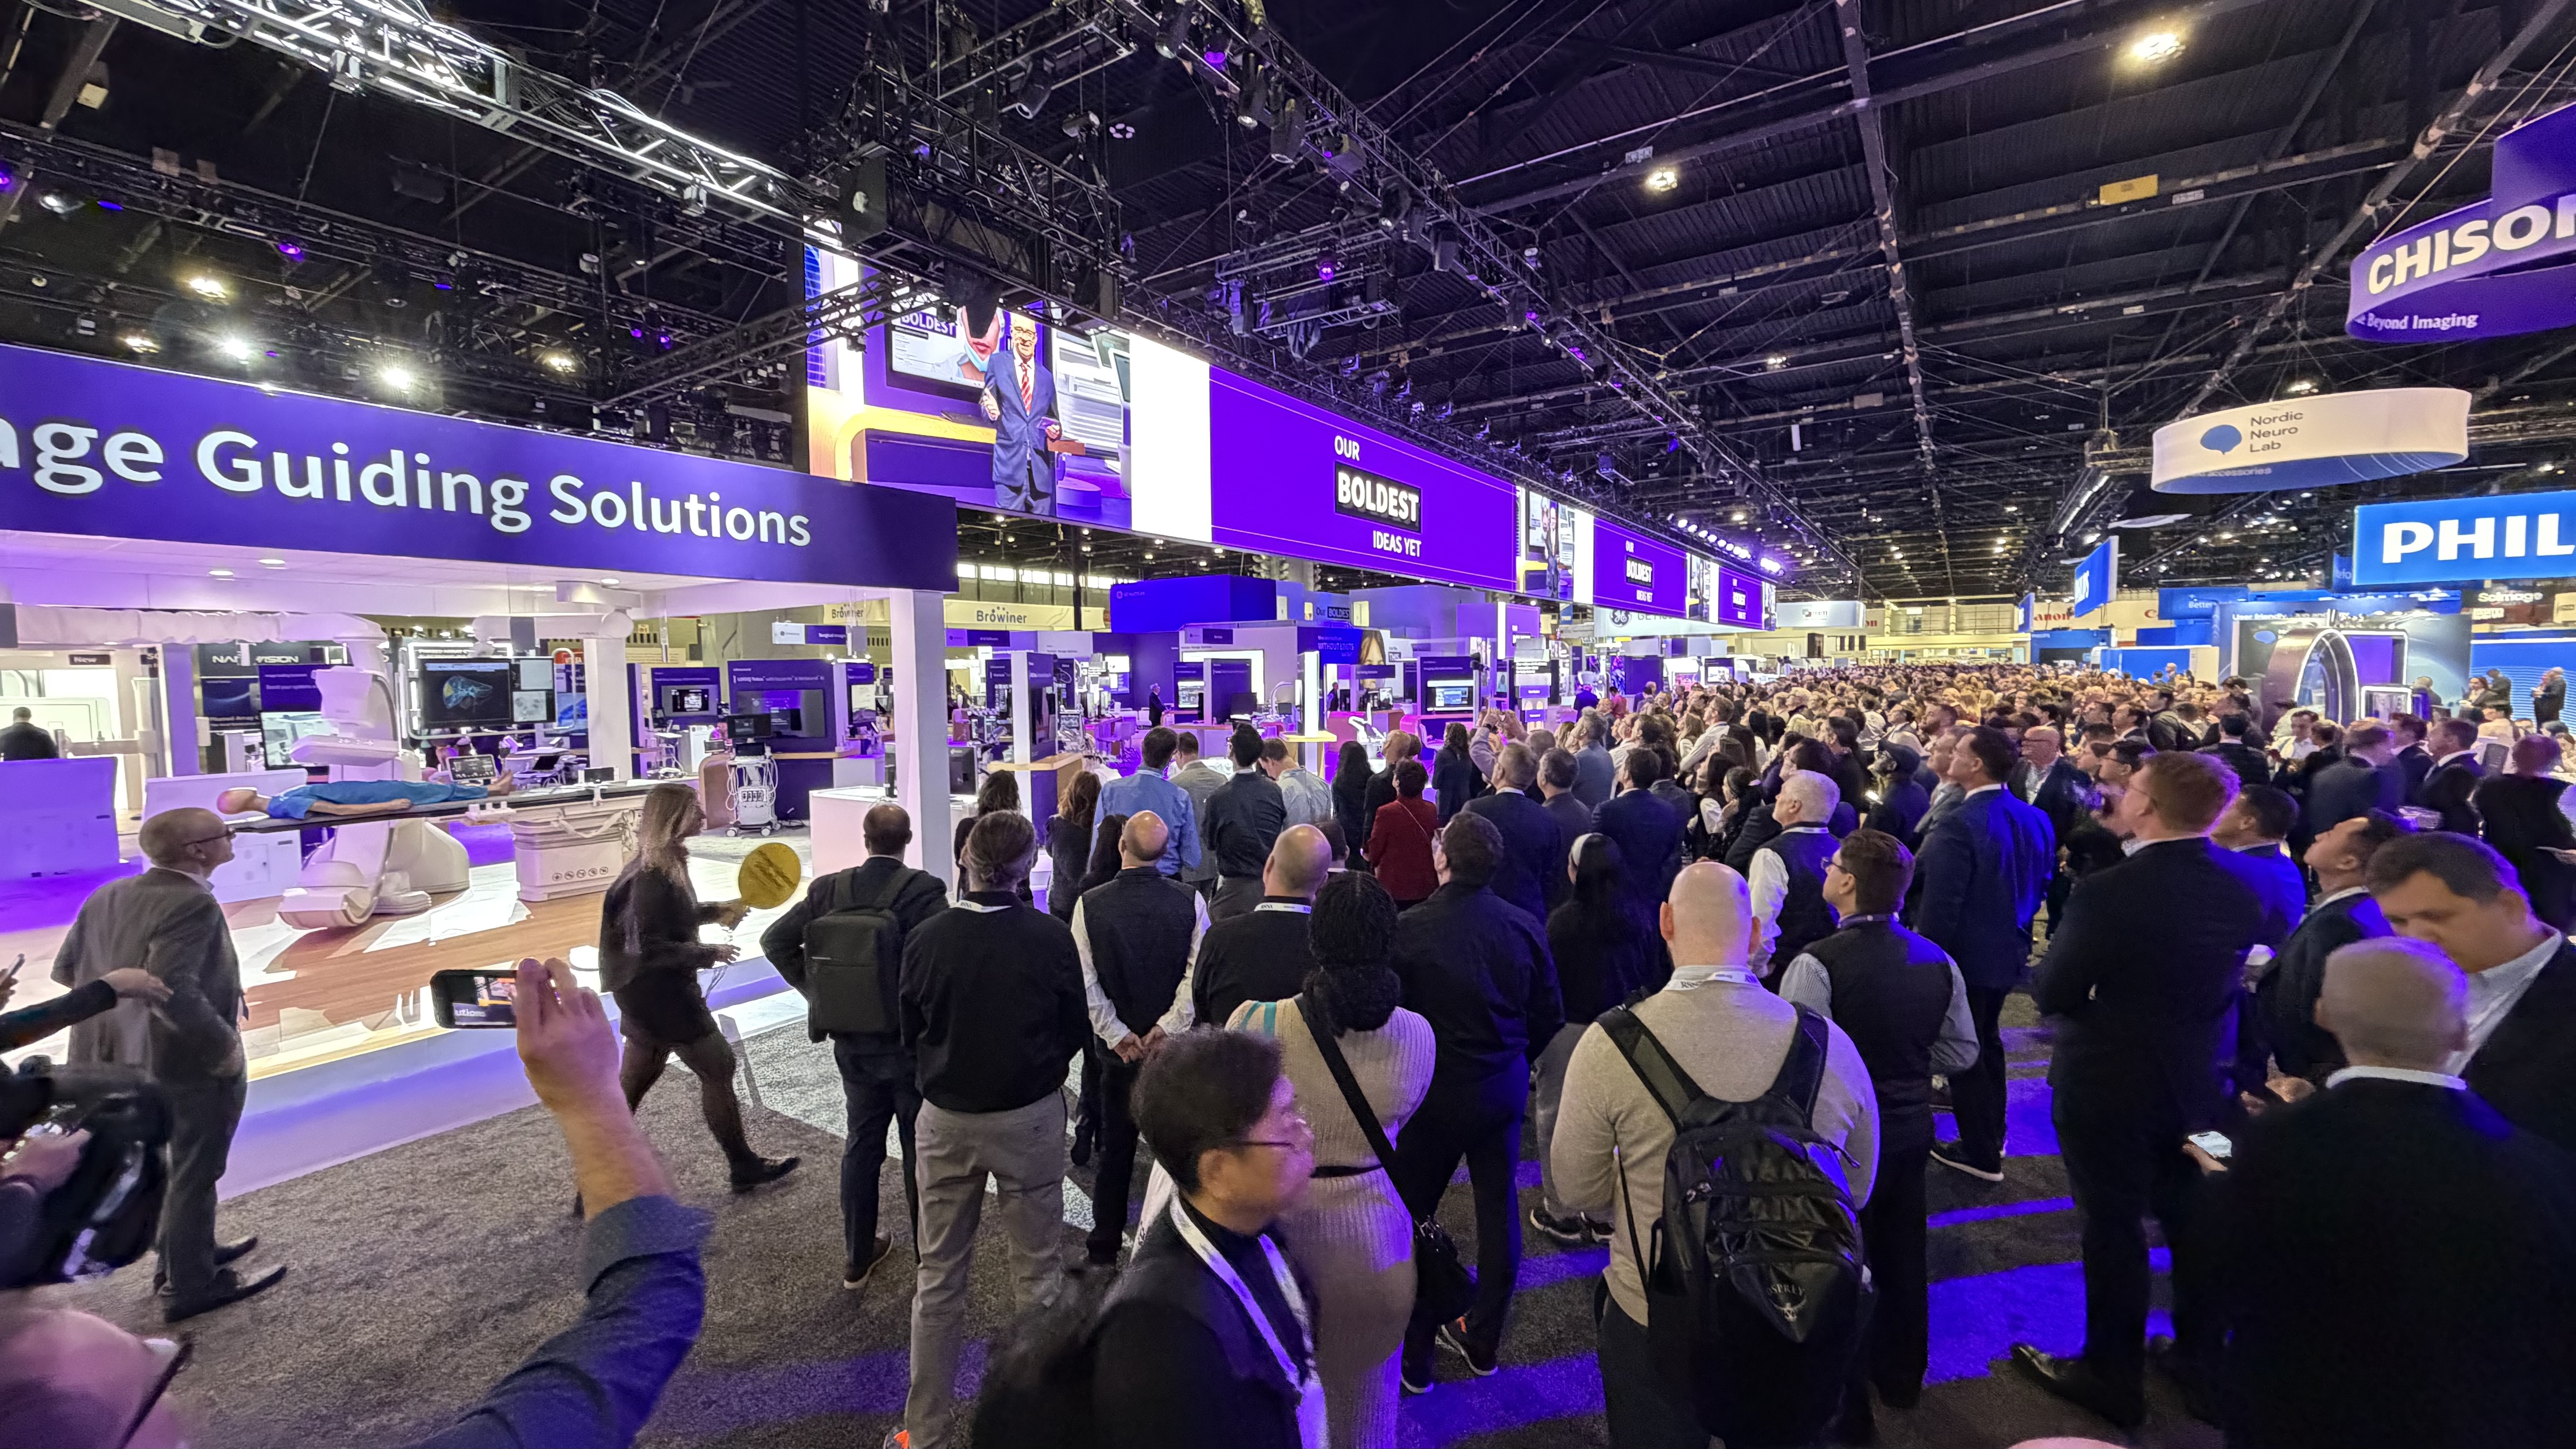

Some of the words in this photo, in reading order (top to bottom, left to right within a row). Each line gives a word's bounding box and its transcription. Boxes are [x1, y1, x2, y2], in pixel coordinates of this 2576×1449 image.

[902, 311, 956, 336] BOLDEST
[2368, 313, 2409, 331] Beyond
[2412, 313, 2479, 331] Imaging
[2251, 410, 2304, 428] Nordic
[2250, 425, 2299, 441] Neuro
[1334, 435, 1360, 461] OUR
[2249, 440, 2281, 454] Lab
[197, 431, 531, 533] Guiding
[549, 475, 811, 547] Solutions
[1338, 471, 1419, 522] BOLDEST
[1373, 530, 1402, 553] IDEAS
[1403, 537, 1421, 557] YET
[2383, 513, 2576, 564] PHIL
[1626, 560, 1653, 583] BOLDEST
[1328, 608, 1350, 618] BOLDES
